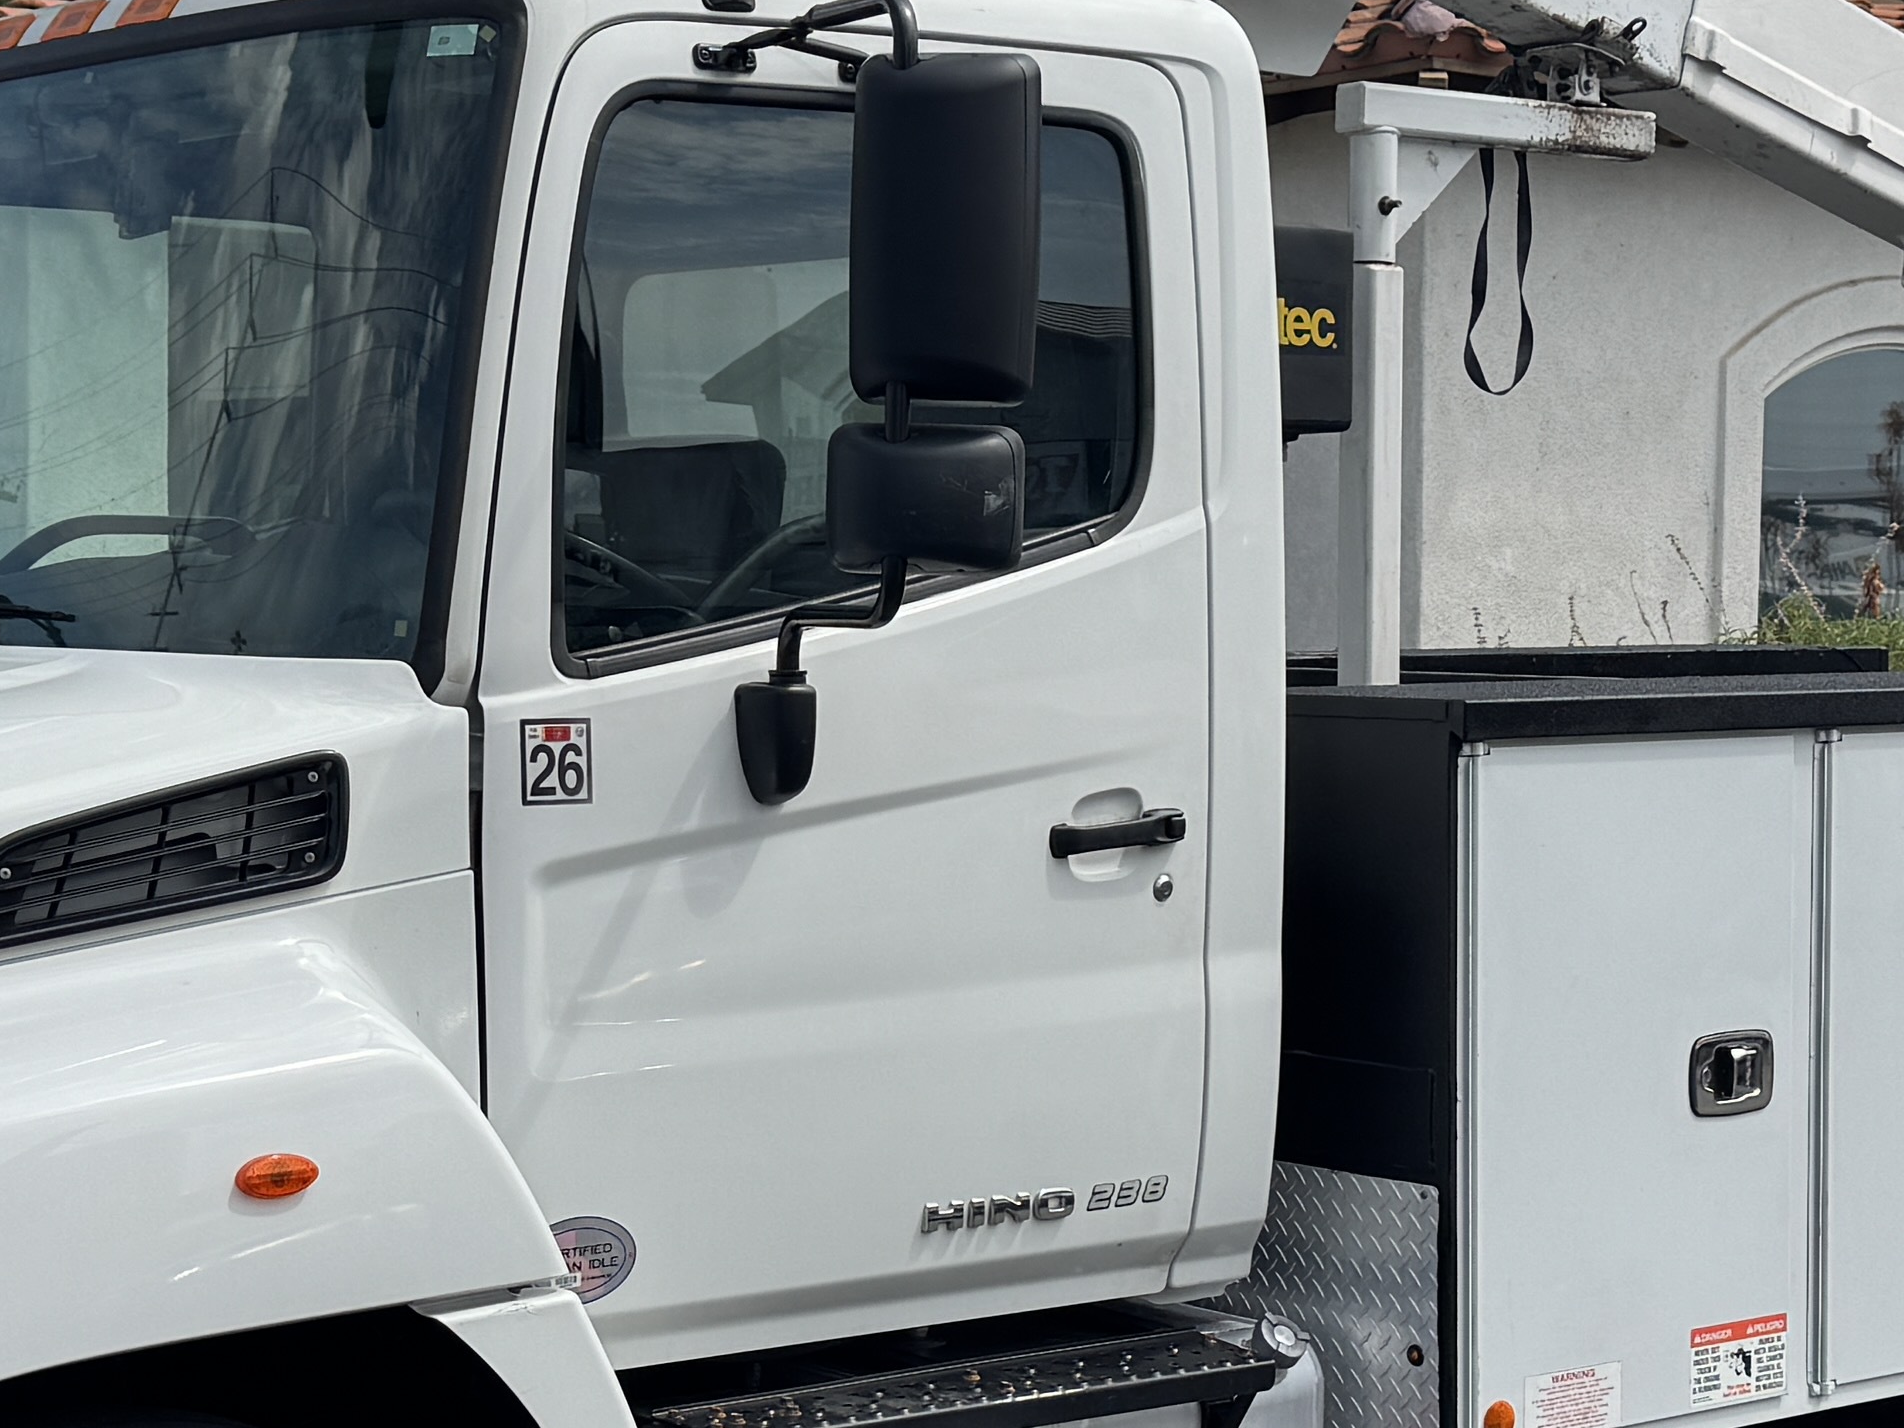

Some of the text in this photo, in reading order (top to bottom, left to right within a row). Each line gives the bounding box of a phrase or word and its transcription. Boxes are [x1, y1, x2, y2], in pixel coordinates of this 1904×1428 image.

[1277, 298, 1335, 347] tec
[529, 742, 585, 797] 26
[921, 1174, 1168, 1233] HINO 238
[561, 1243, 613, 1259] RTIFIED
[589, 1256, 619, 1270] IDLE
[1551, 1368, 1596, 1384] WARNING
